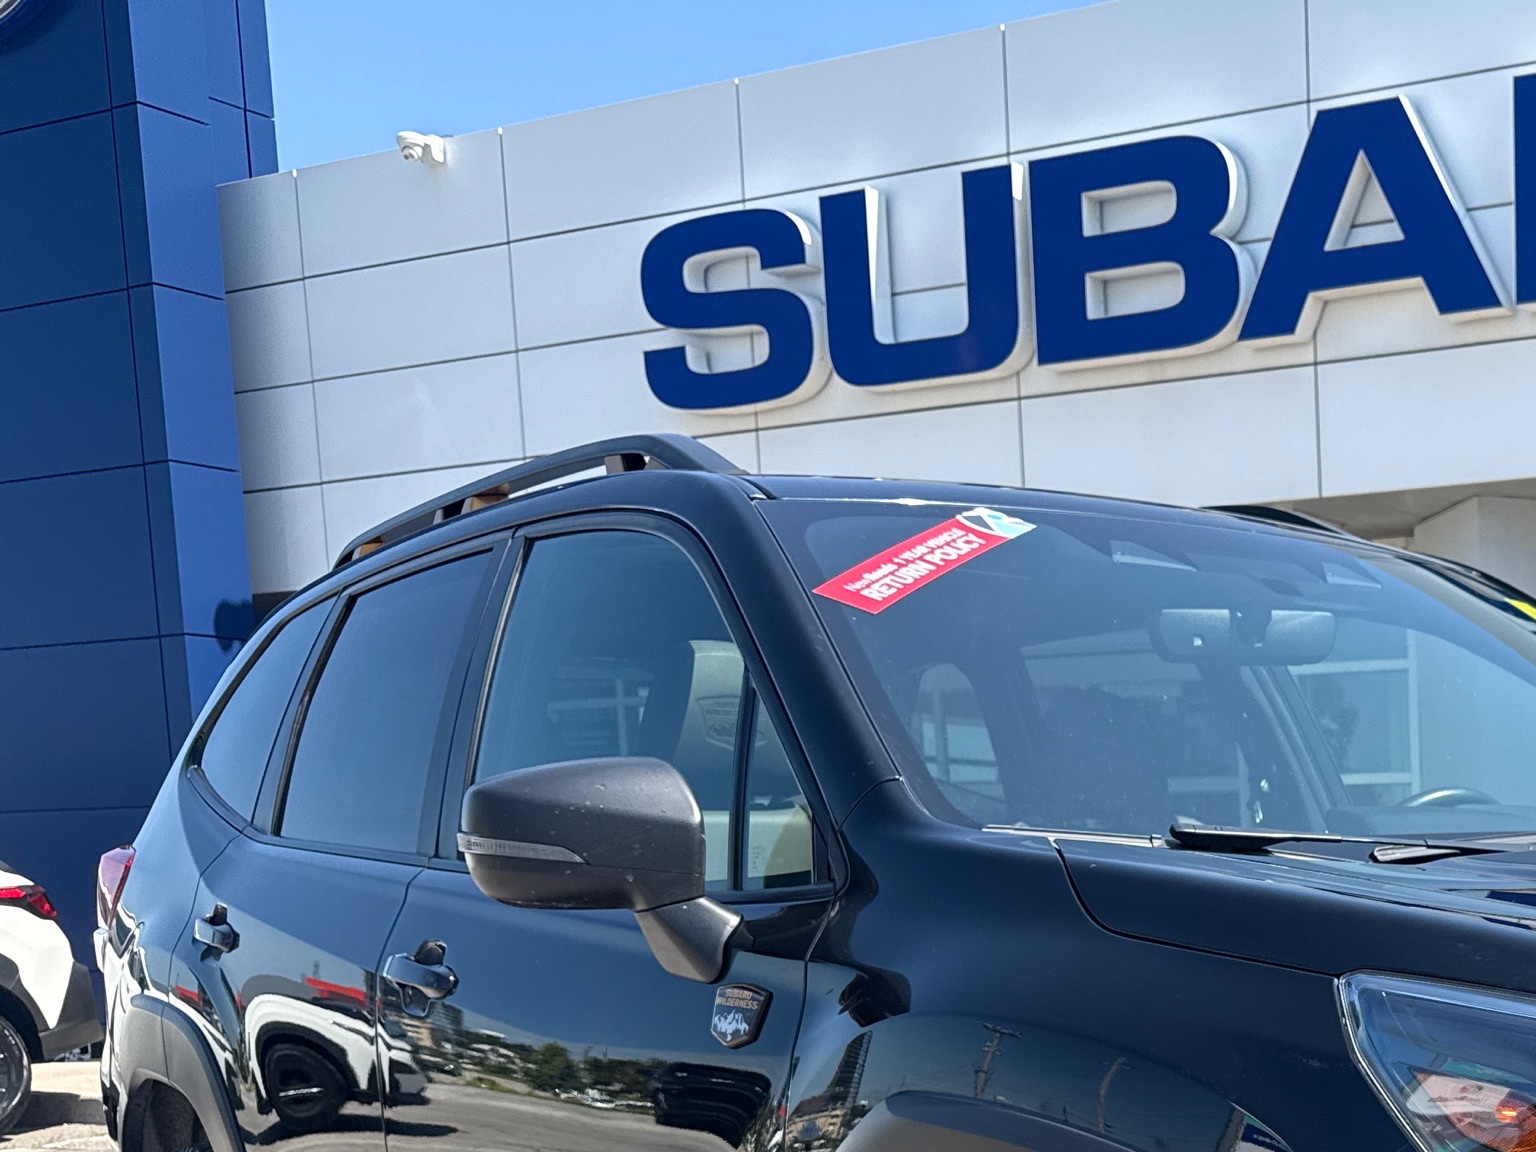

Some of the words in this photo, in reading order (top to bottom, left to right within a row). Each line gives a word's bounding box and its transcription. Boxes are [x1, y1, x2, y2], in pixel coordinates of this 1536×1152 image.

[923, 527, 966, 548] VEHICLE
[898, 545, 931, 560] YEAR
[859, 560, 937, 601] RETURN
[923, 533, 986, 565] POLICY
[892, 557, 907, 565] 1
[725, 989, 753, 1000] SUBARU
[716, 997, 759, 1010] WILDERNESS
